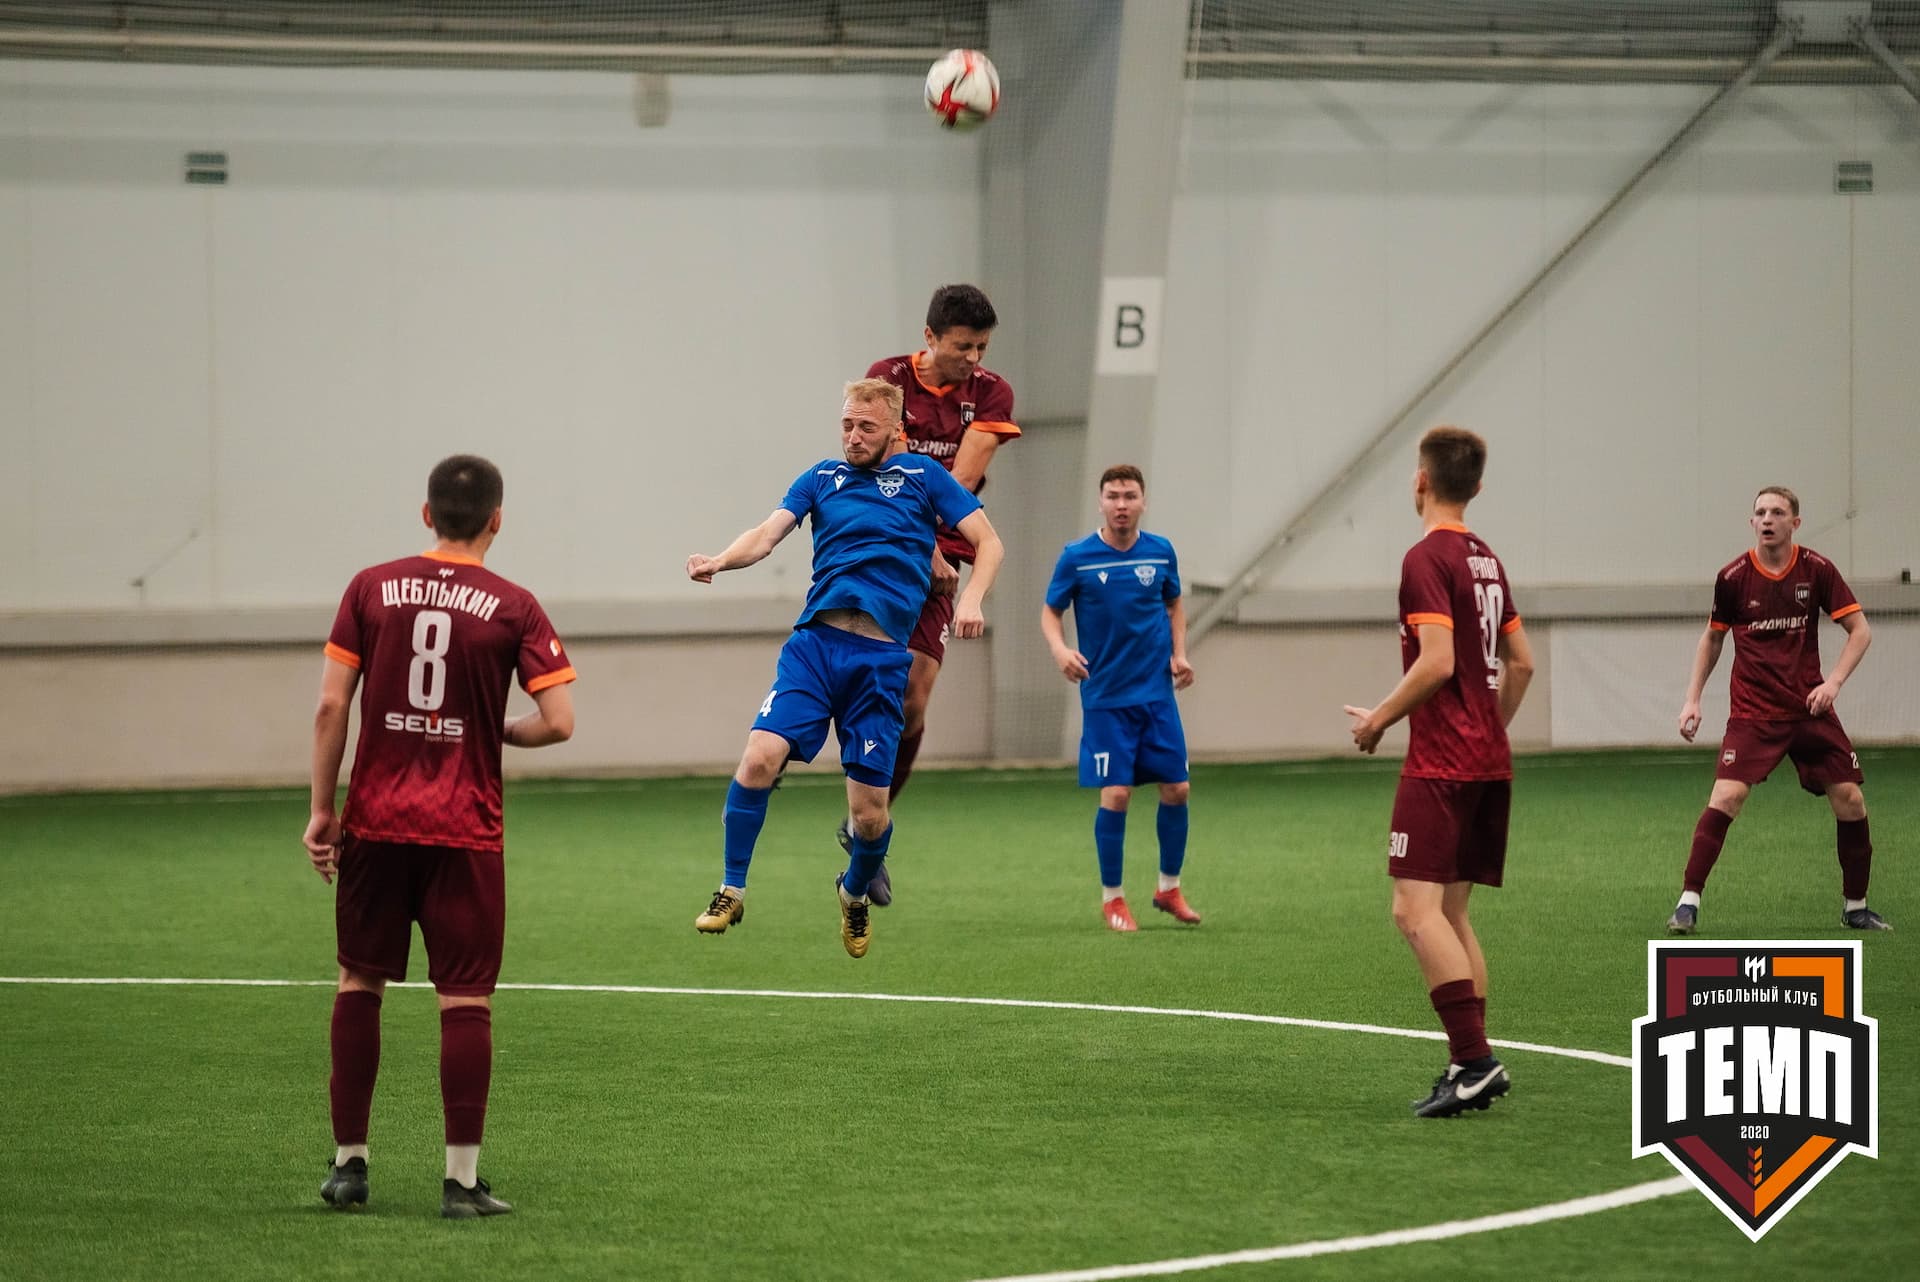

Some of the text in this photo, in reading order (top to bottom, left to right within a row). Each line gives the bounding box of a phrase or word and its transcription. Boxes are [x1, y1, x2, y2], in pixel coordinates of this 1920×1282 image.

[381, 578, 500, 621] ЩЕБЛЫКИН
[408, 610, 452, 711] 8
[760, 690, 777, 717] 4
[385, 712, 464, 736] SEUS
[1094, 752, 1109, 777] 17
[1390, 832, 1409, 858] 30
